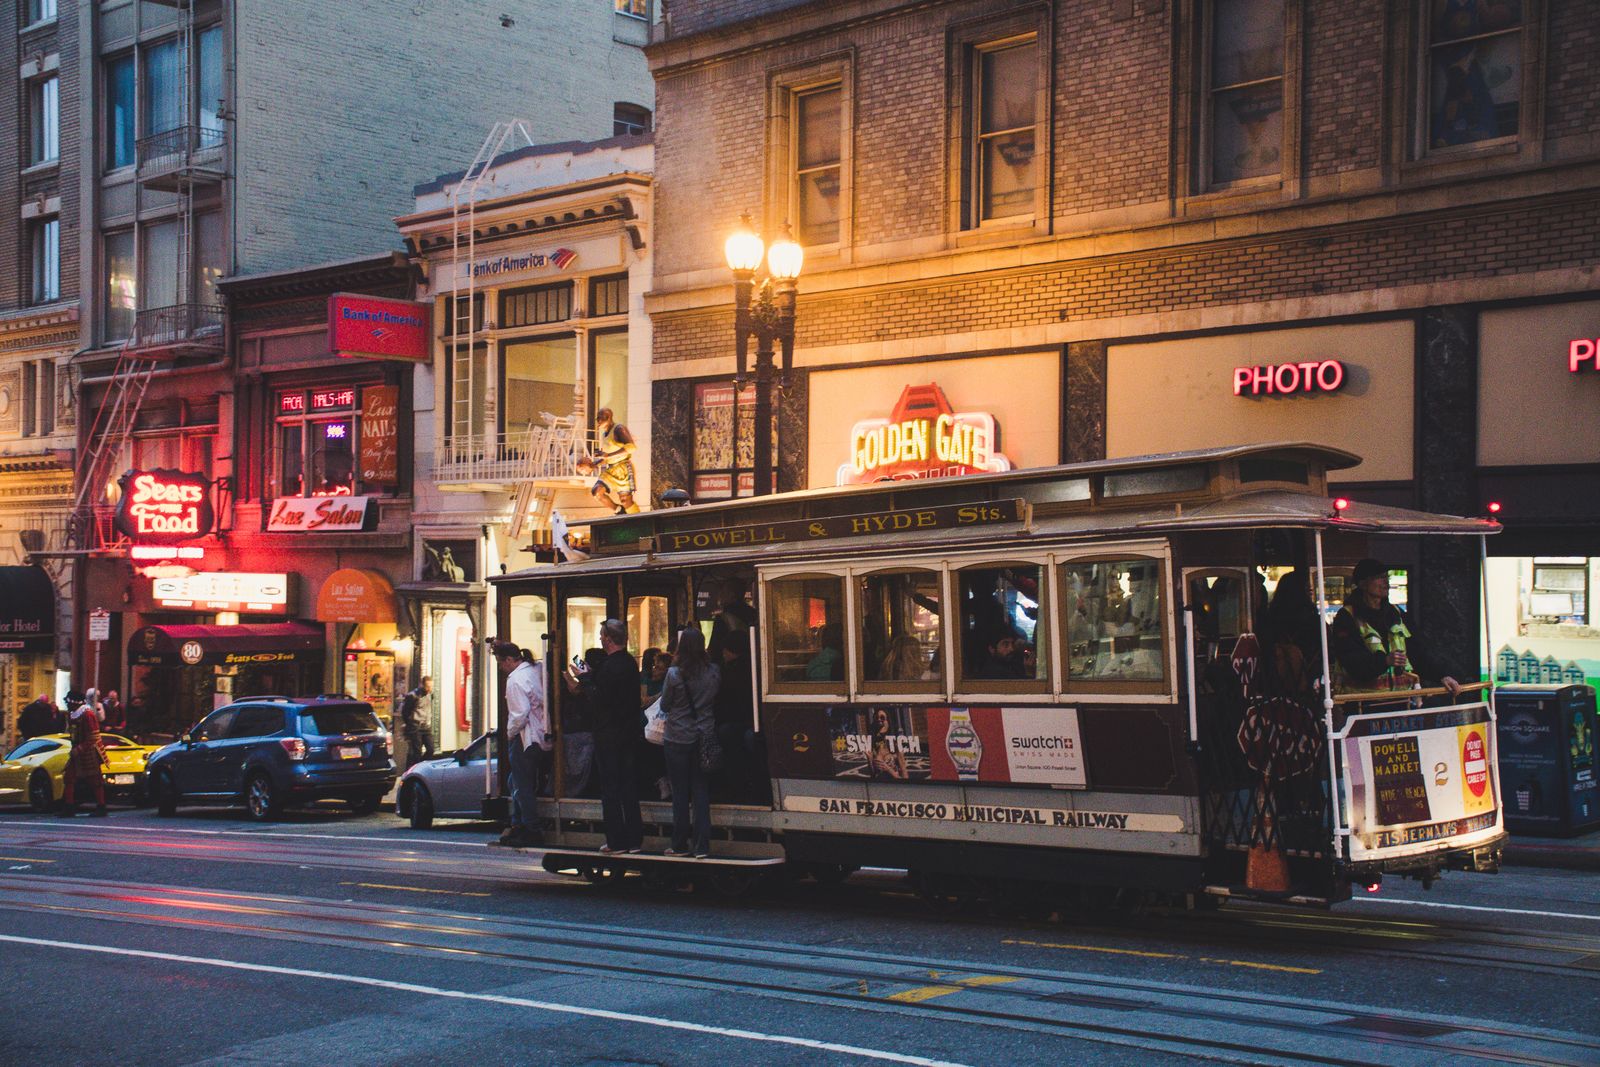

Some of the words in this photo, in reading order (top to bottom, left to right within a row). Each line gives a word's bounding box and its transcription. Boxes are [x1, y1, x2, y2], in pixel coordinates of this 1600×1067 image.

[492, 259, 503, 273] of
[503, 252, 545, 272] America
[343, 307, 370, 320] Bank
[372, 312, 382, 321] of
[384, 312, 423, 327] America
[1233, 360, 1343, 396] PHOTO
[365, 395, 397, 417] Lux
[853, 419, 930, 475] GOLDEN
[936, 413, 989, 471] GATE
[133, 475, 202, 502] Sears
[131, 502, 199, 534] Food
[271, 500, 304, 526] Lux
[307, 500, 363, 528] Salon
[673, 527, 785, 549] POWELL
[808, 522, 828, 537] &
[852, 511, 937, 533] HYDE
[957, 506, 1006, 523] Sts.
[14, 619, 41, 632] Hotel
[184, 643, 201, 658] 80
[225, 653, 251, 663] Sears
[1370, 716, 1424, 732] MARKET
[792, 732, 809, 753] 2
[1011, 736, 1063, 749] swatch
[1374, 742, 1417, 756] POWELL
[1375, 761, 1420, 776] MARKET
[1387, 754, 1409, 763] AND
[1434, 761, 1449, 787] 2
[819, 799, 850, 813] SAN
[856, 801, 947, 818] FRANCISCO
[953, 805, 1046, 824] MUNICIPAL
[1053, 811, 1128, 829] RAILWAY
[1376, 822, 1458, 847] FISHERMAN'S
